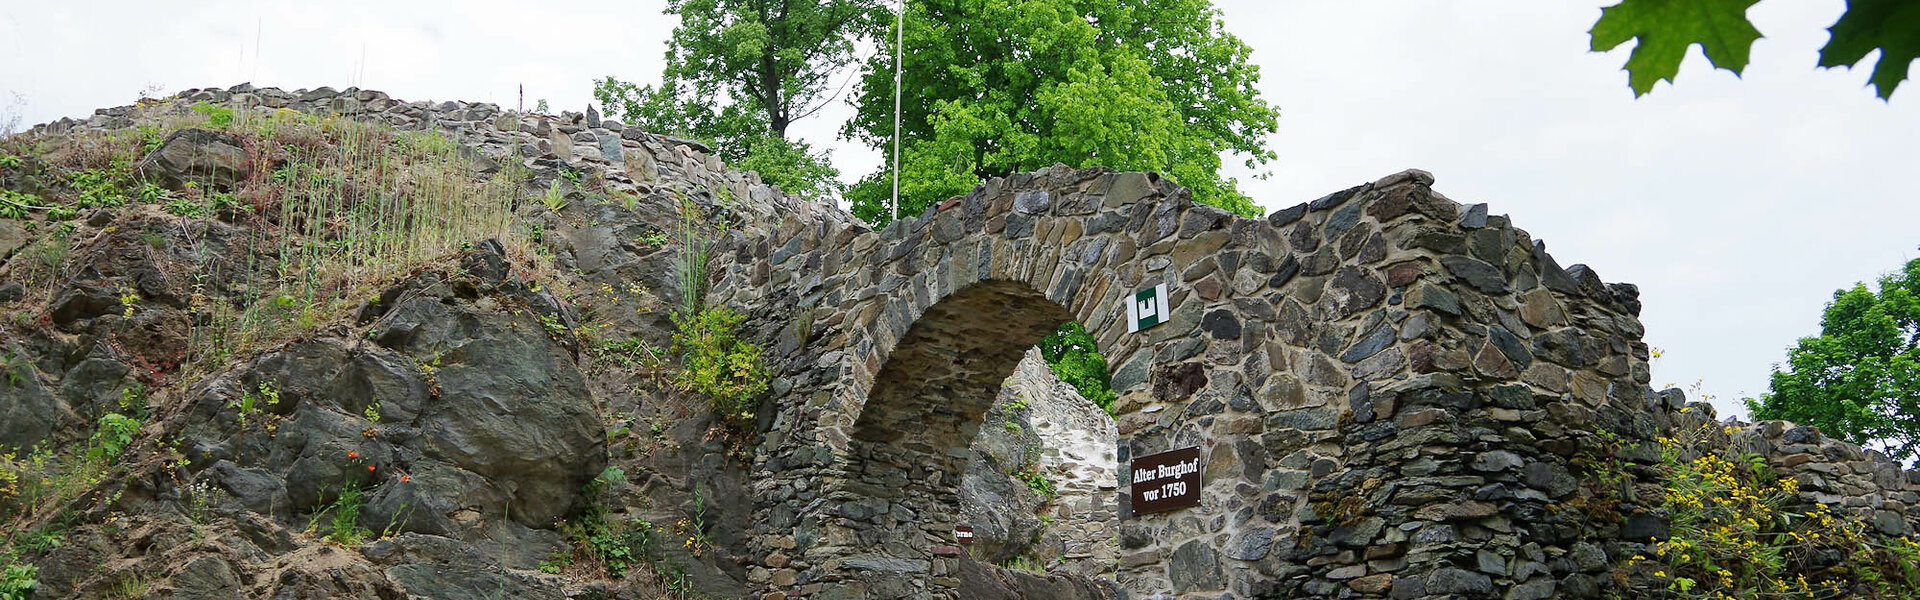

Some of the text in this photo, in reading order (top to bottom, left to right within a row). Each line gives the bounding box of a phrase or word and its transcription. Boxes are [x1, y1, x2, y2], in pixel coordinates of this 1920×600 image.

[1133, 457, 1199, 484] Alter Burghof
[1143, 481, 1187, 501] vor 1750
